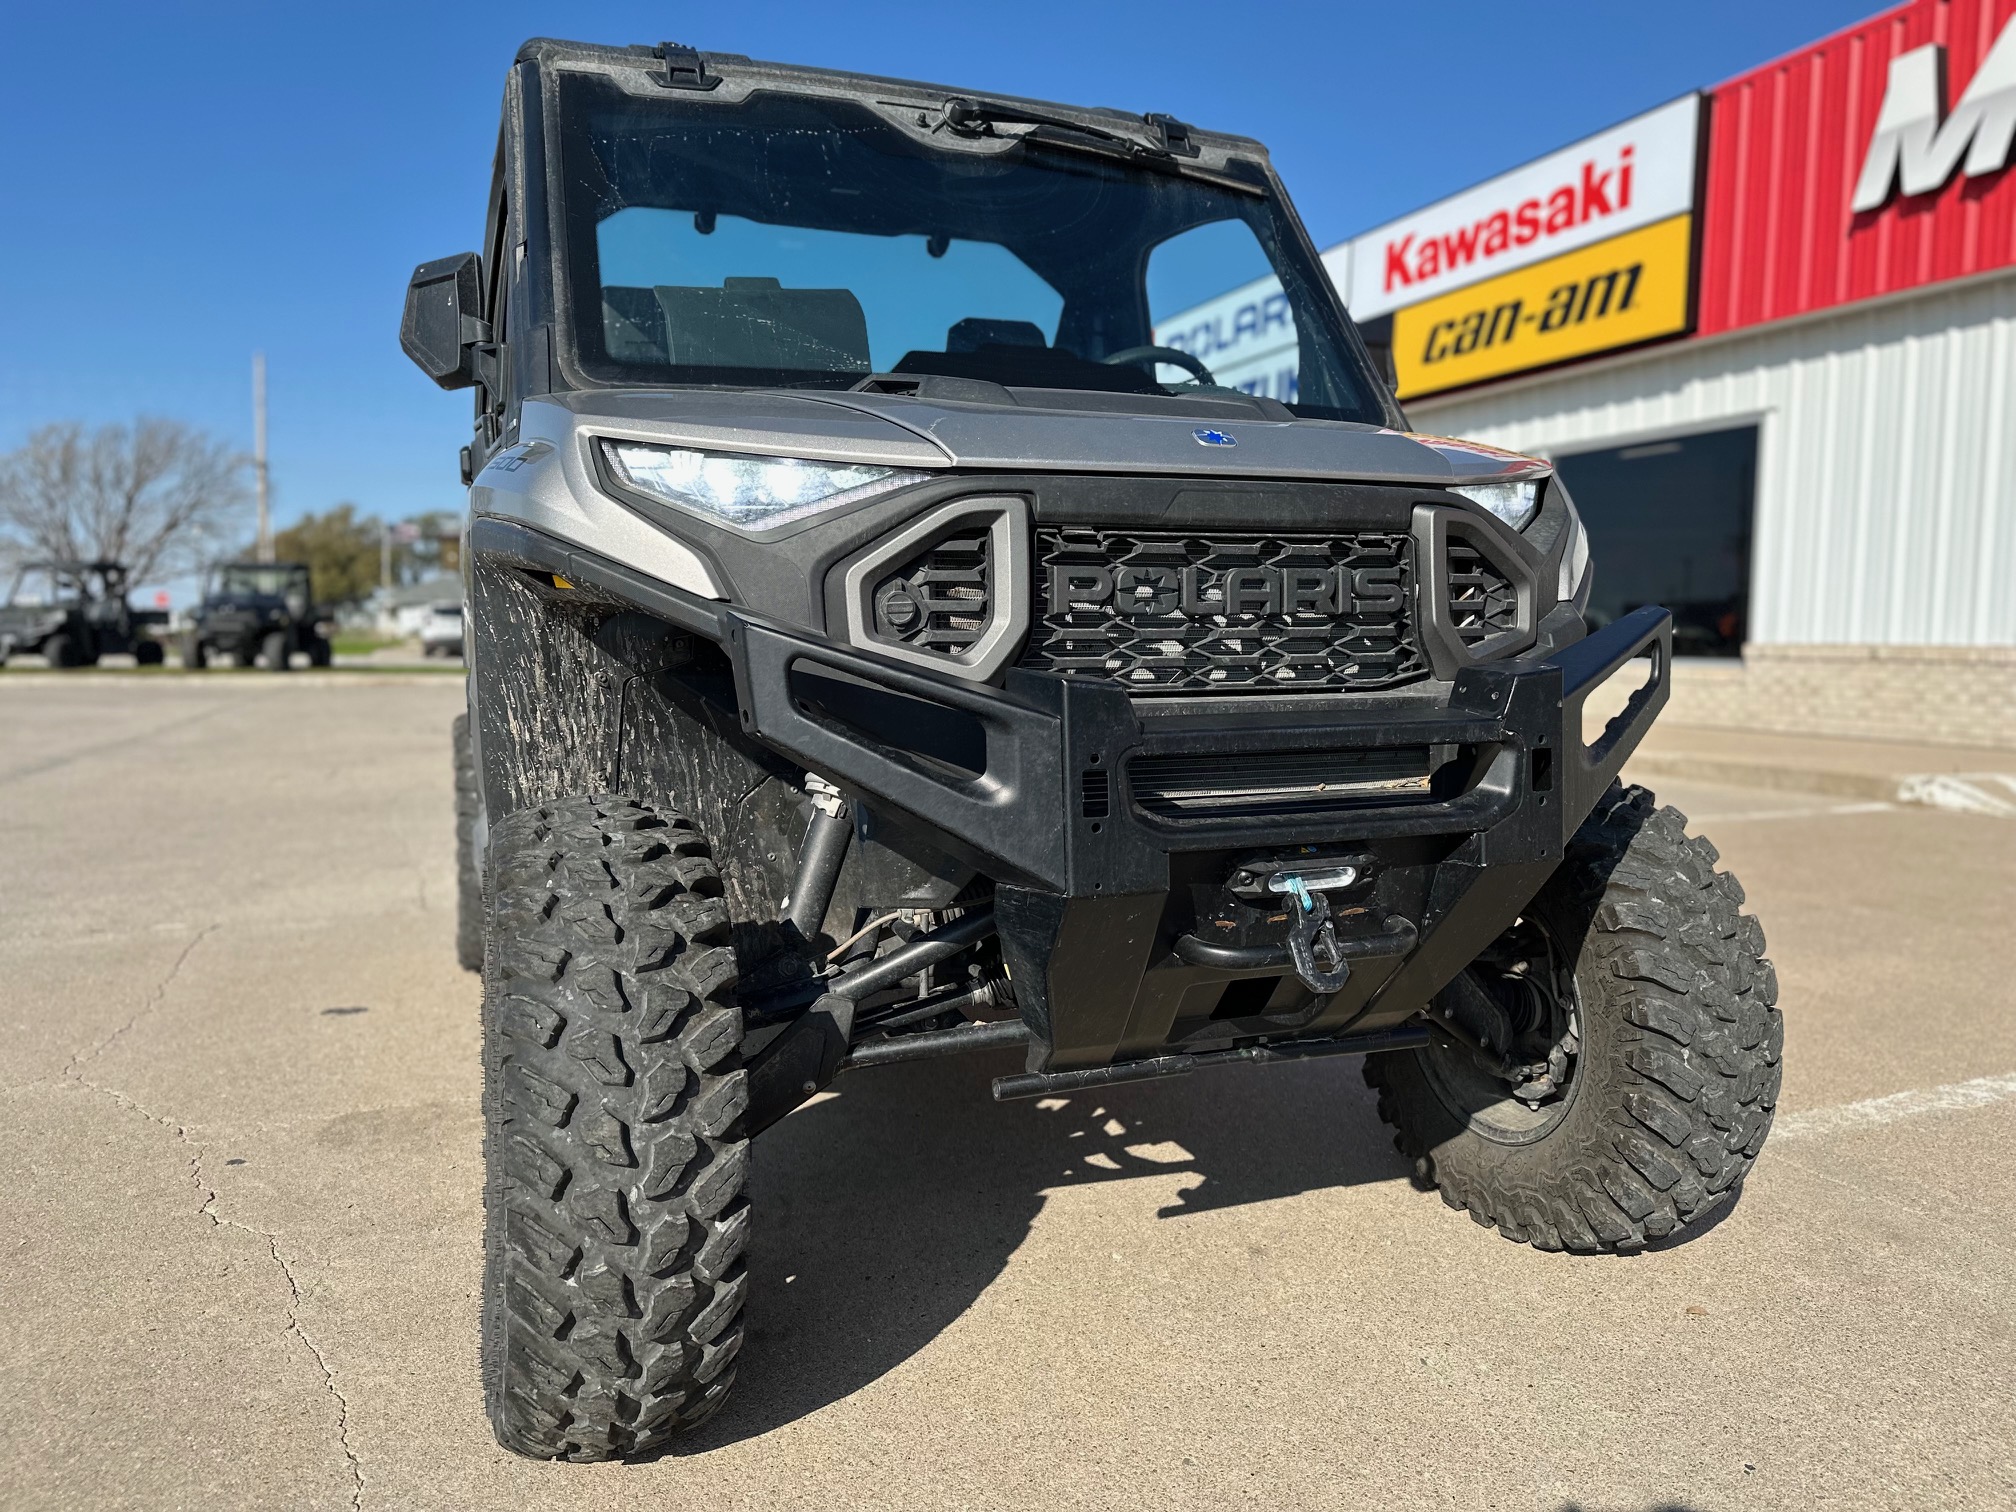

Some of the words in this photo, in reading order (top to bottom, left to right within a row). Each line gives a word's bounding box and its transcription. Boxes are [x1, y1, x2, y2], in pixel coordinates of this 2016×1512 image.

[1384, 145, 1635, 293] Kawasaki
[1166, 293, 1290, 362] POLAR
[1421, 262, 1643, 365] can-am
[1050, 566, 1403, 616] POLARIS
